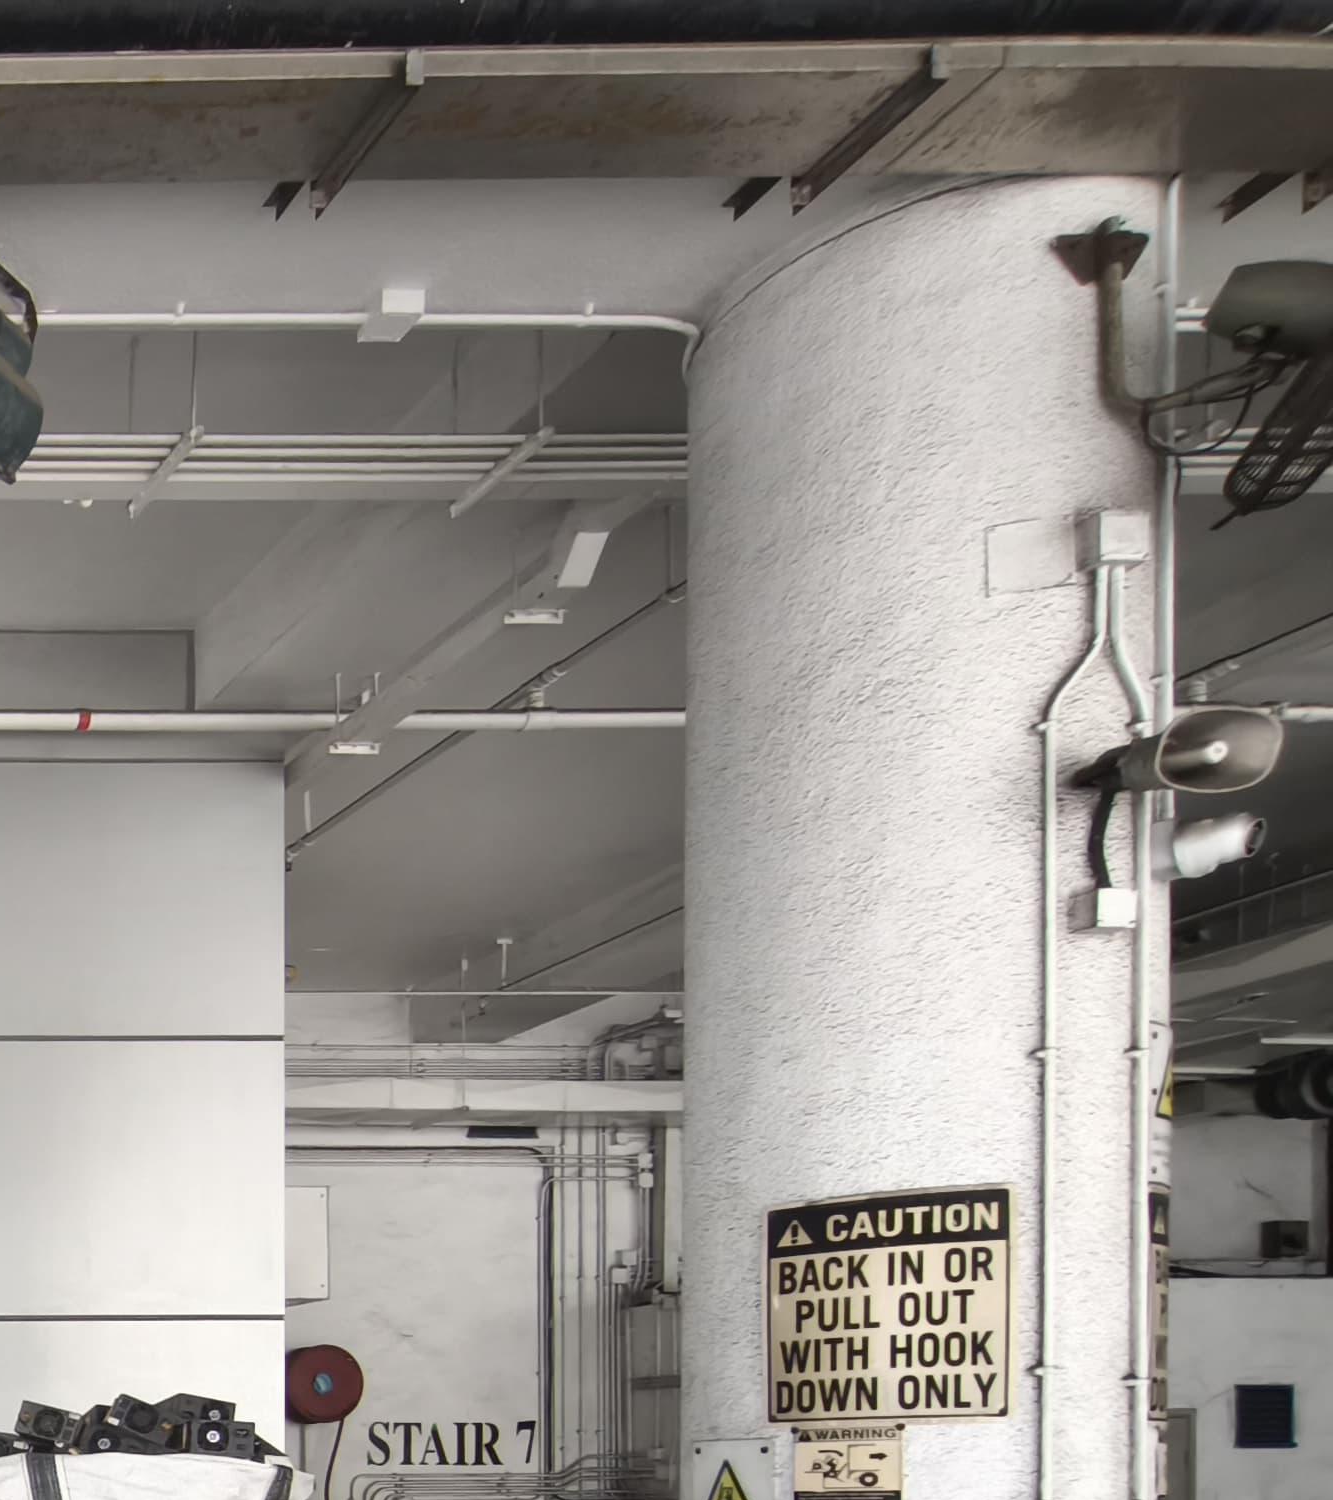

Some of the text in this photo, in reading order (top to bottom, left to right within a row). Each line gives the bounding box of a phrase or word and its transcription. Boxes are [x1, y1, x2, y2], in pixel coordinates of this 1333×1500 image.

[825, 1201, 1000, 1242] CAUTION
[778, 1246, 993, 1296] BACK IN OR
[795, 1289, 975, 1334] PULL OUT
[779, 1330, 993, 1375] WITH HOOK
[775, 1373, 997, 1415] DOWN ONLY
[367, 1420, 537, 1467] STAIR 7
[815, 1428, 896, 1440] WARNING
